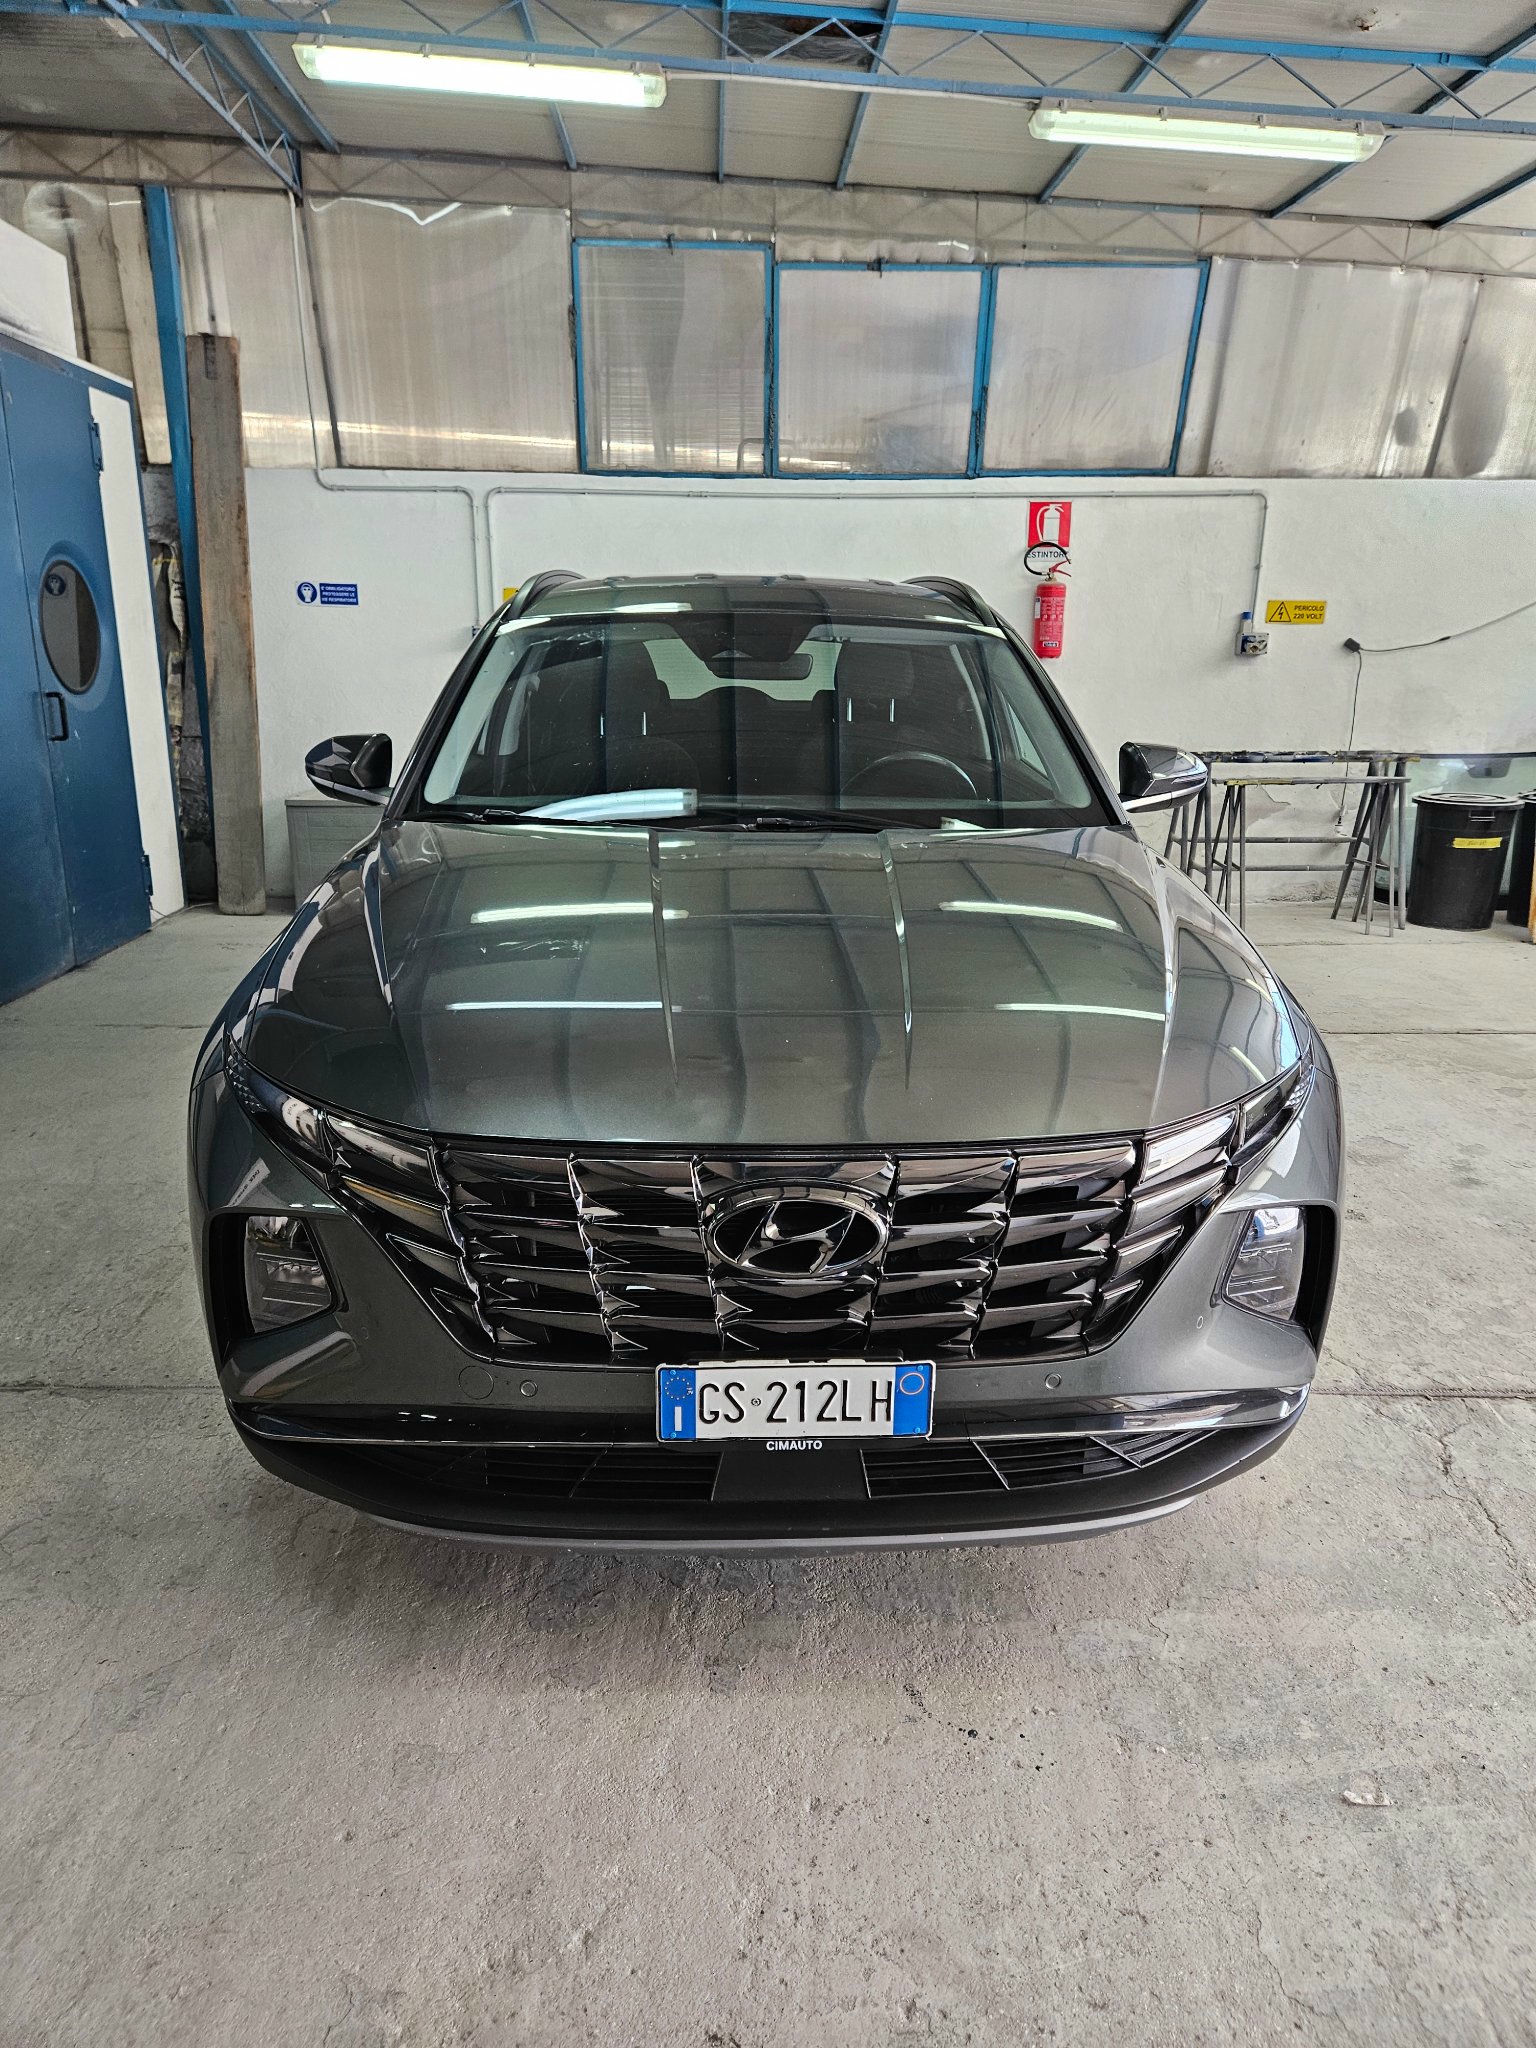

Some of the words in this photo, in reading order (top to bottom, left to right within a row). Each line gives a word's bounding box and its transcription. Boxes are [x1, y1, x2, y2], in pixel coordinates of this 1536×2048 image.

[1027, 551, 1069, 559] ESTINTOR
[699, 1381, 746, 1425] GS
[766, 1440, 823, 1451] CIMAUTO
